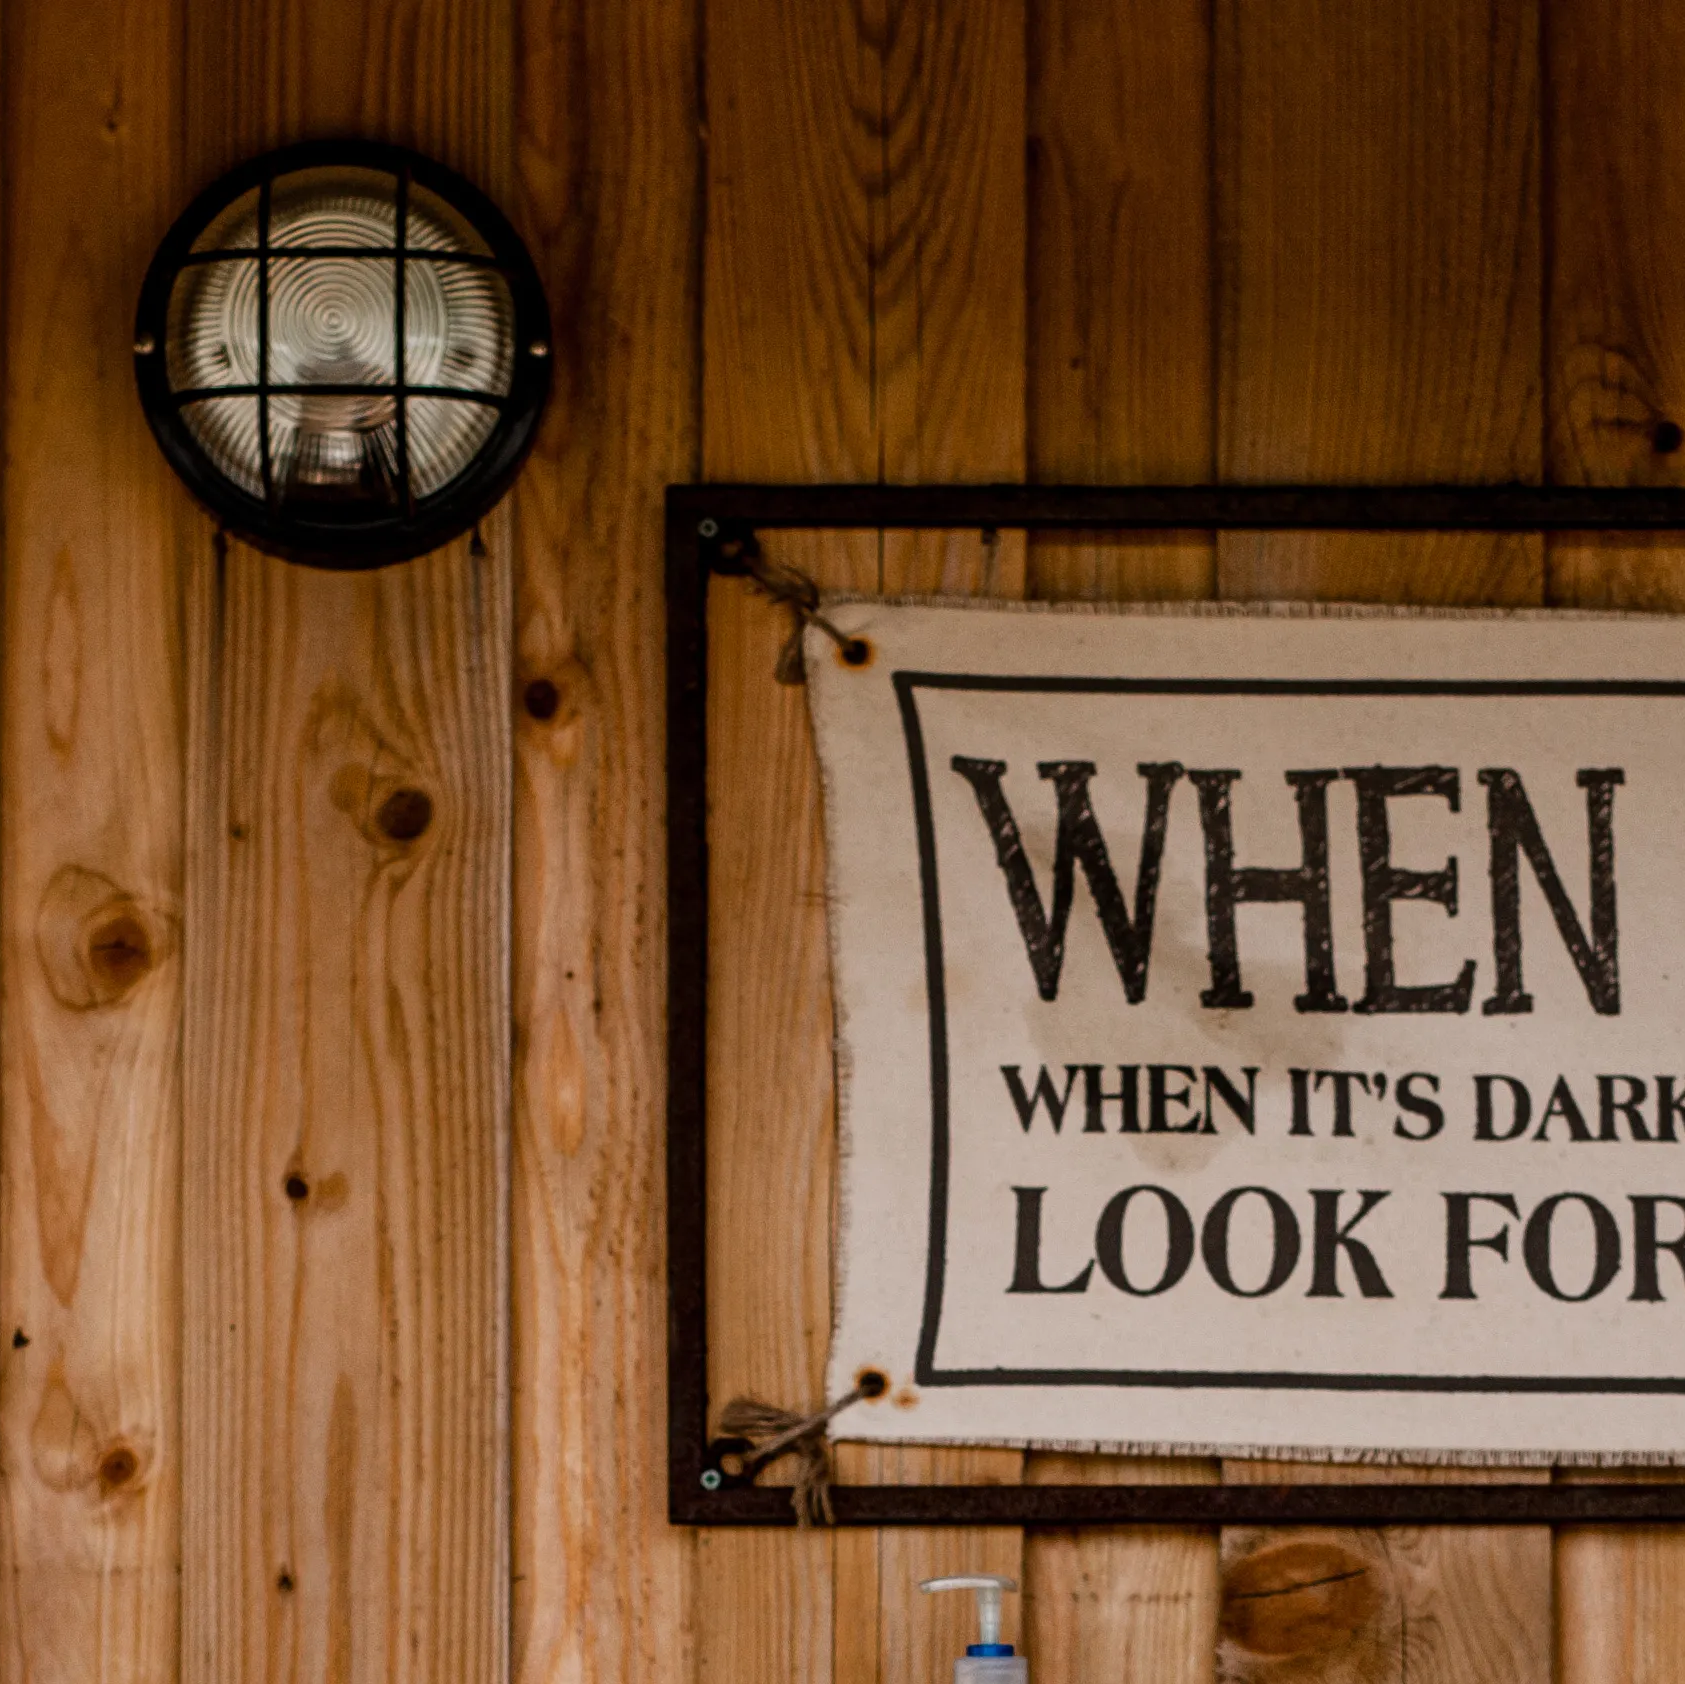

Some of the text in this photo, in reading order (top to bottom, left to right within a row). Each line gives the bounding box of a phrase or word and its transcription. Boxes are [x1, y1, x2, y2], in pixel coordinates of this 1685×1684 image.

[950, 754, 1626, 1017] WHEN
[1000, 1063, 1261, 1135] WHEN
[1287, 1067, 1444, 1141] IT'S
[1006, 1185, 1394, 1298] LOOK
